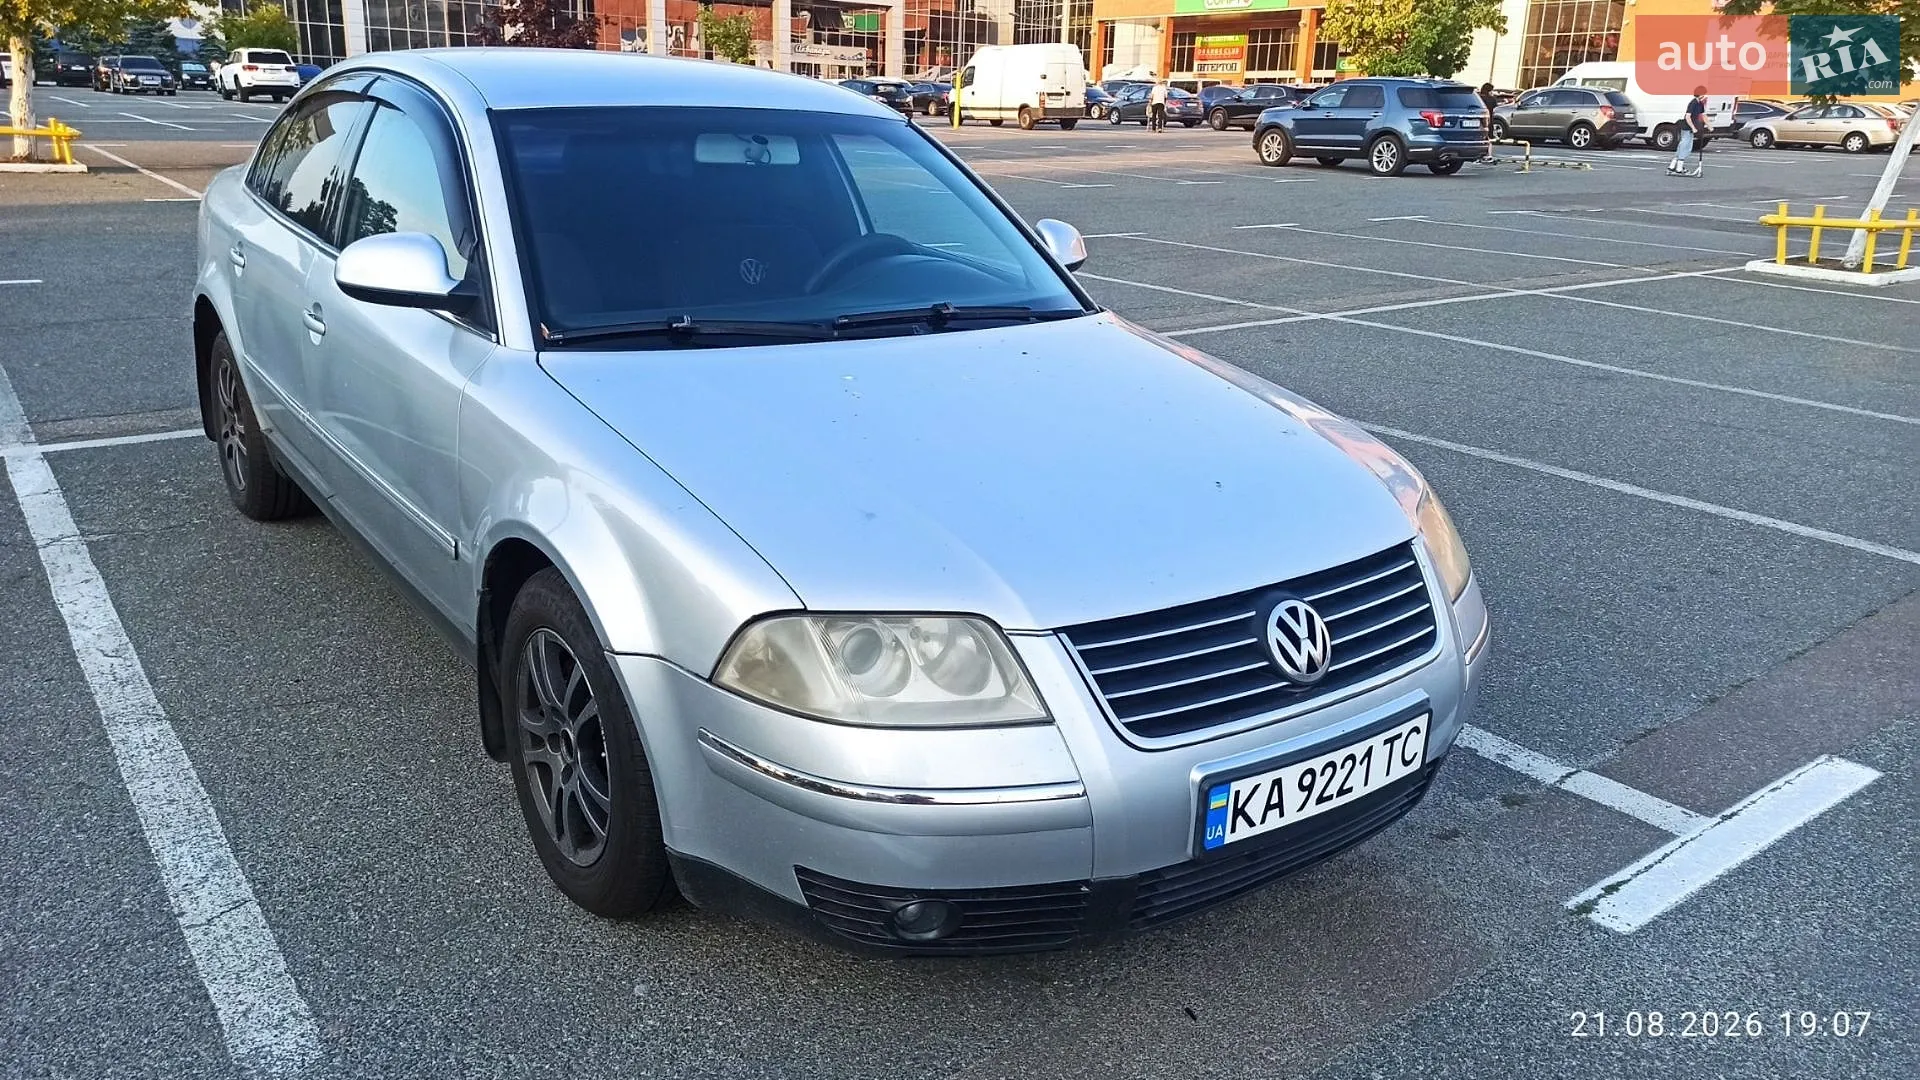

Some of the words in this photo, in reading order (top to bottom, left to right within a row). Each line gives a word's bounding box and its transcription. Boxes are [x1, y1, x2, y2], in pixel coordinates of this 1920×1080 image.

[1230, 776, 1285, 834] KA
[1296, 745, 1374, 813] 9221
[1383, 725, 1421, 777] TC
[1207, 824, 1224, 841] UA
